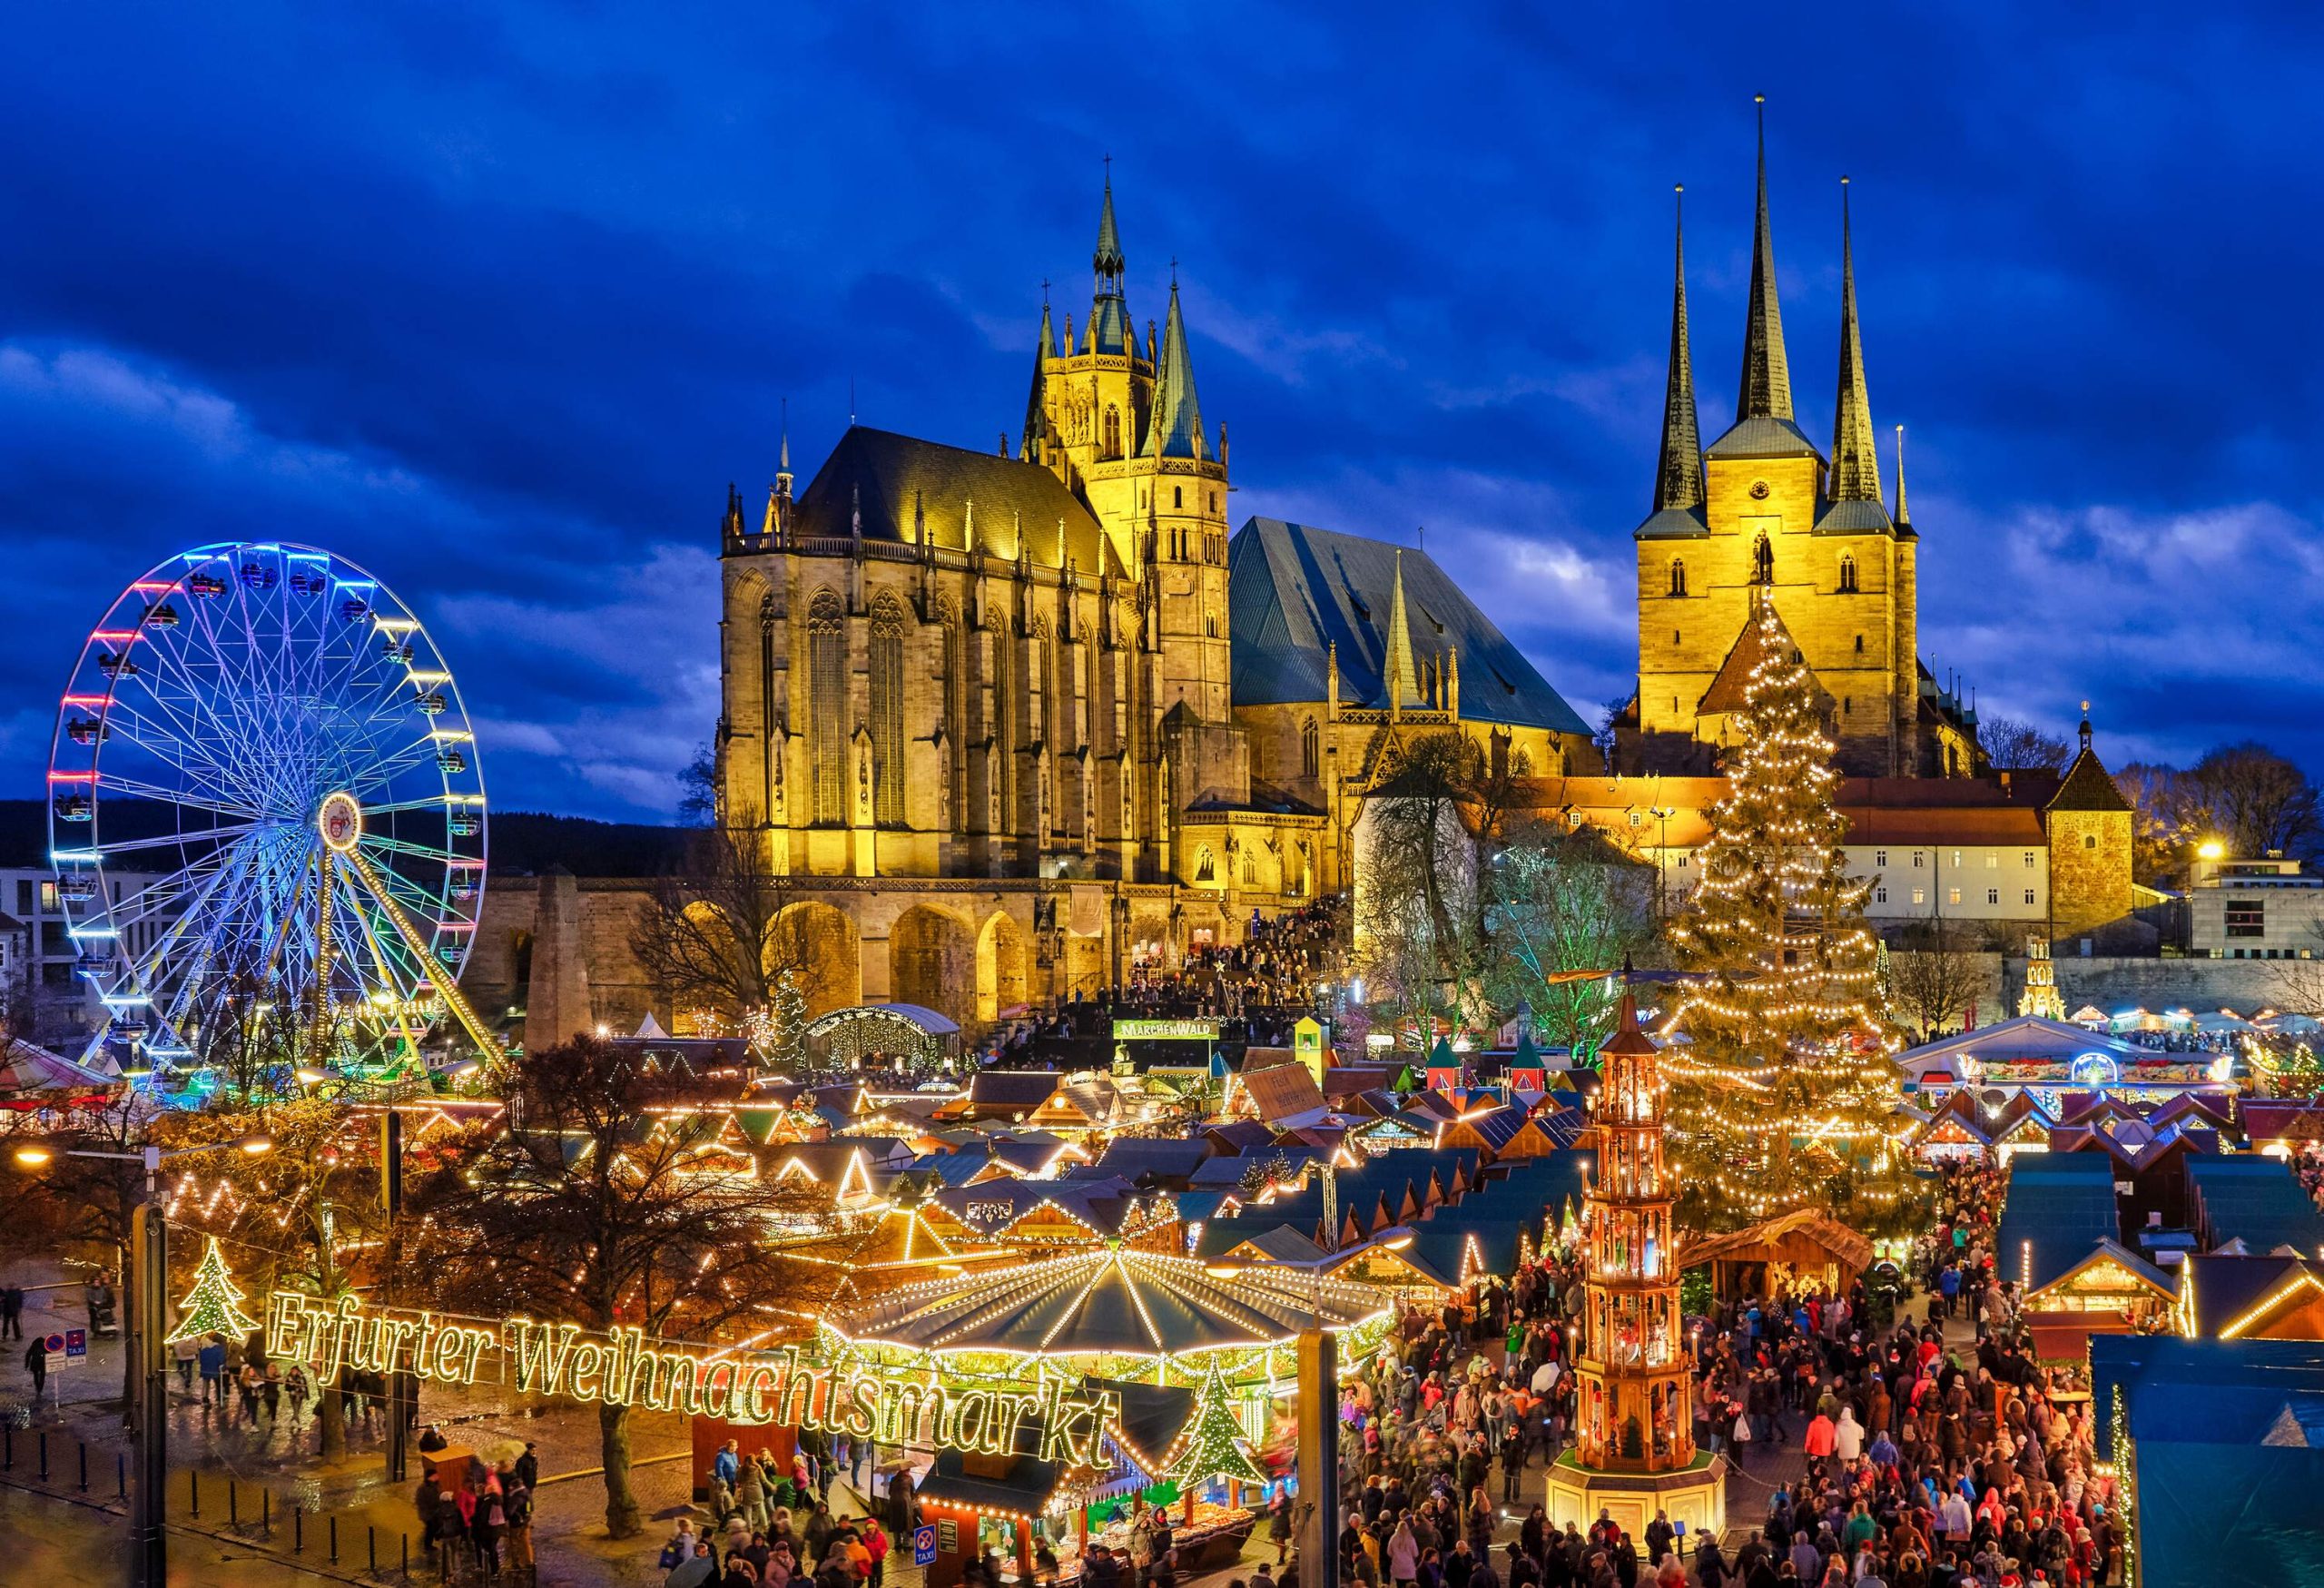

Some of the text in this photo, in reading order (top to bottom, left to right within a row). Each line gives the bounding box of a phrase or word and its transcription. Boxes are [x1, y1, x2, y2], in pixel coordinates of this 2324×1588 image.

[266, 1290, 1118, 1470] Erfurter Weihnachtsmarkt
[917, 1551, 934, 1562] TAXI
